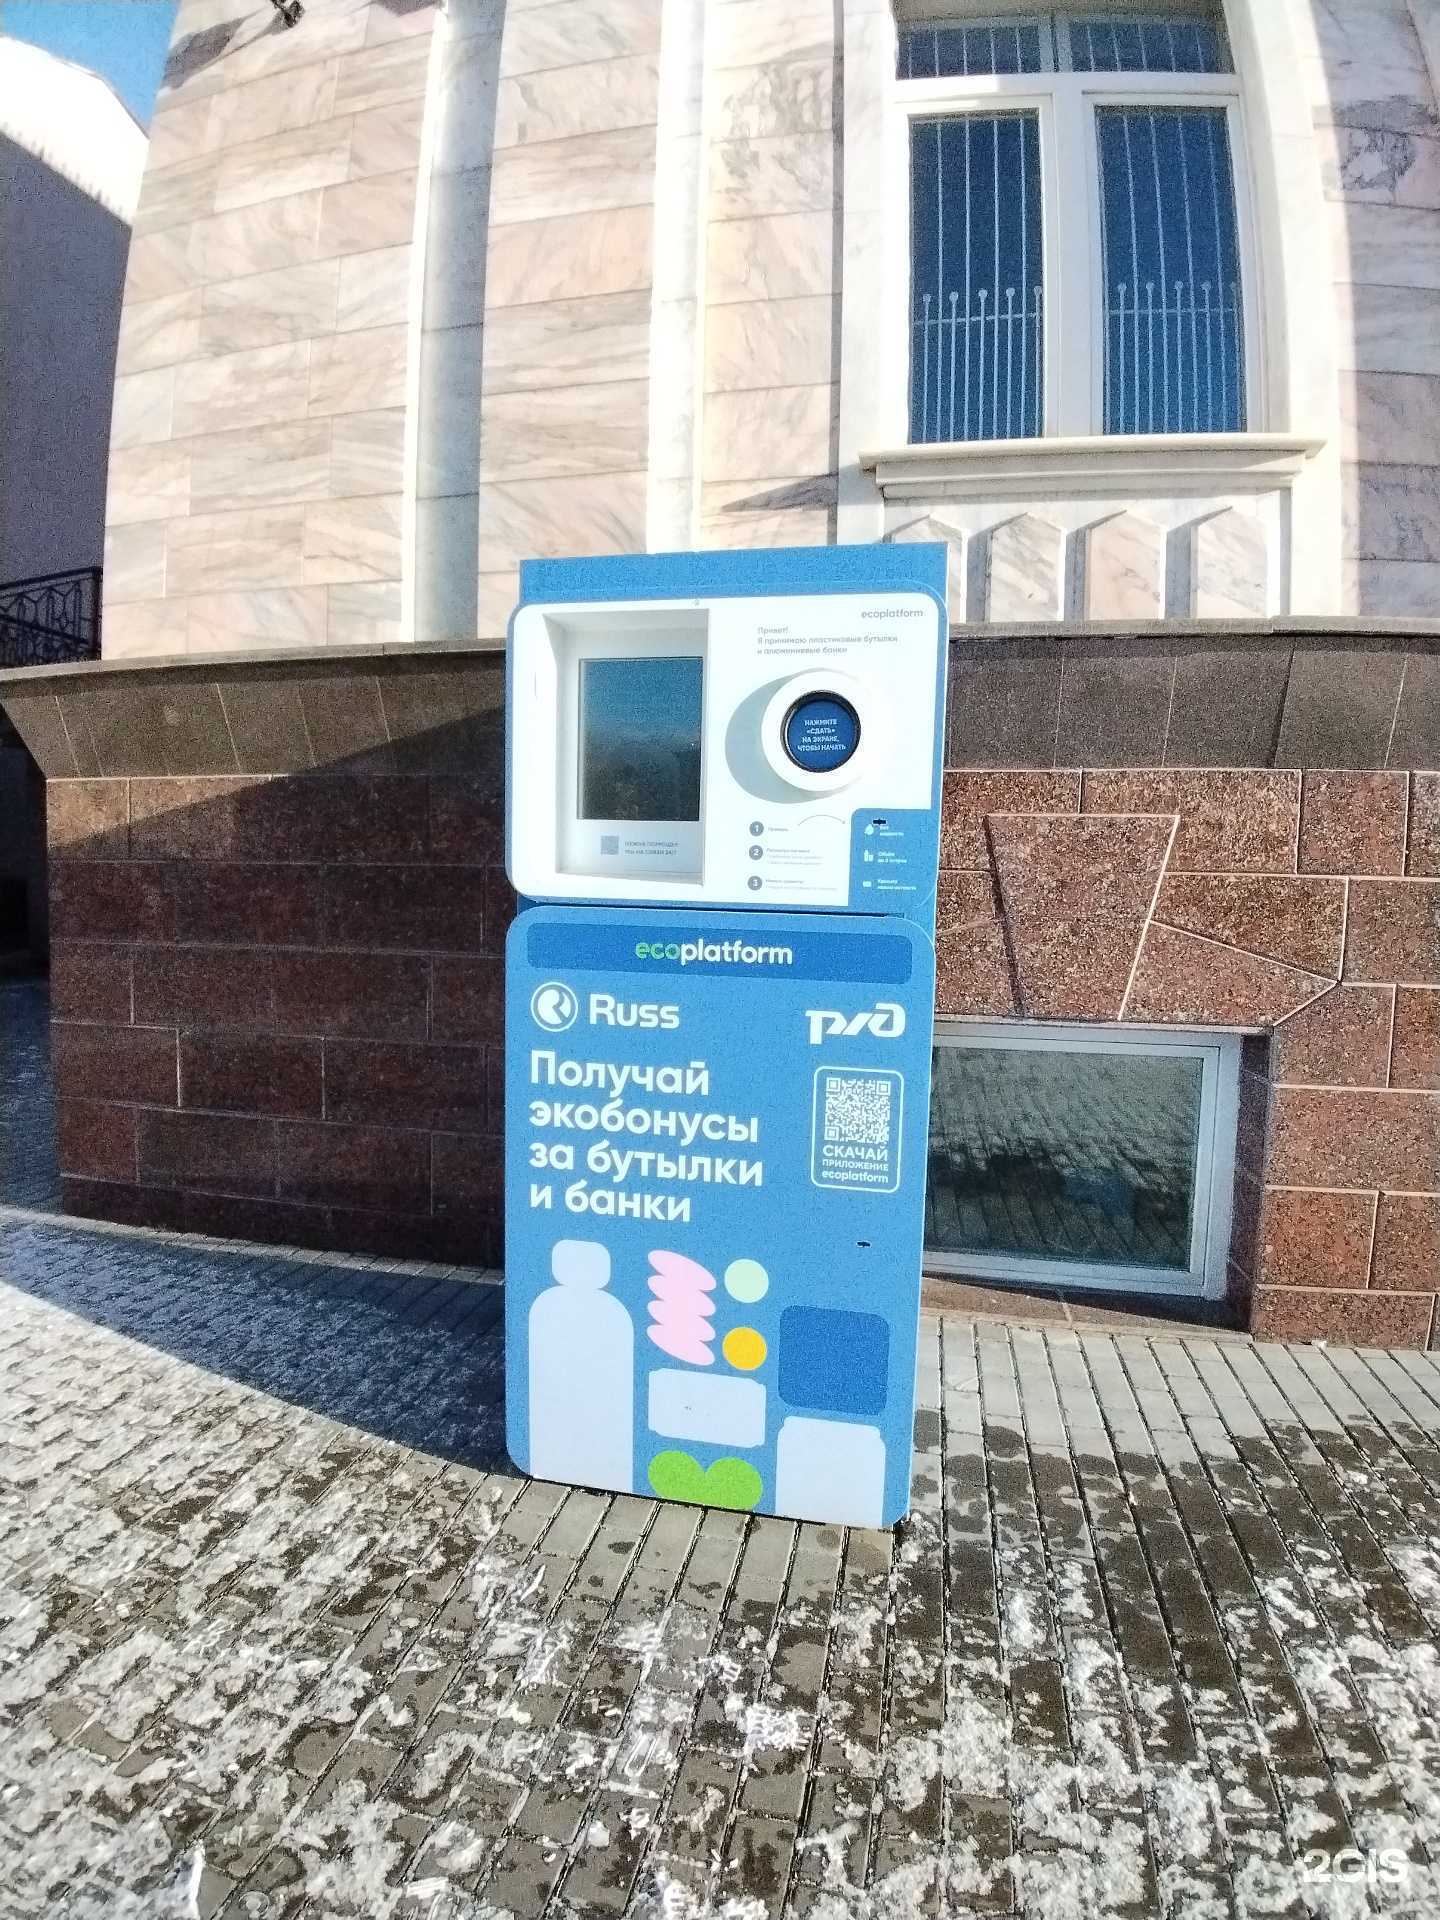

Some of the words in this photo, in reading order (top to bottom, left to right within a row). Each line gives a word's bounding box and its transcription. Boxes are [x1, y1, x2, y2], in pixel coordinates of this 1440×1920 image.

[861, 609, 923, 620] ecoplatform
[758, 626, 789, 636] Привет!
[822, 646, 848, 654] банки
[797, 744, 820, 752] ЧТОБЫ
[634, 937, 793, 966] ecoplatform
[588, 993, 681, 1030] Russ
[530, 1049, 710, 1099] Получай
[528, 1099, 759, 1147] экобонусы
[822, 1144, 889, 1162] СКАЧАЙ
[528, 1141, 574, 1170] за
[586, 1138, 764, 1187] бутылки
[822, 1159, 889, 1172] ПРИЛОЖЕНИЕ
[821, 1170, 889, 1184] ecoplatform
[529, 1184, 552, 1209] и
[564, 1179, 691, 1223] банки
